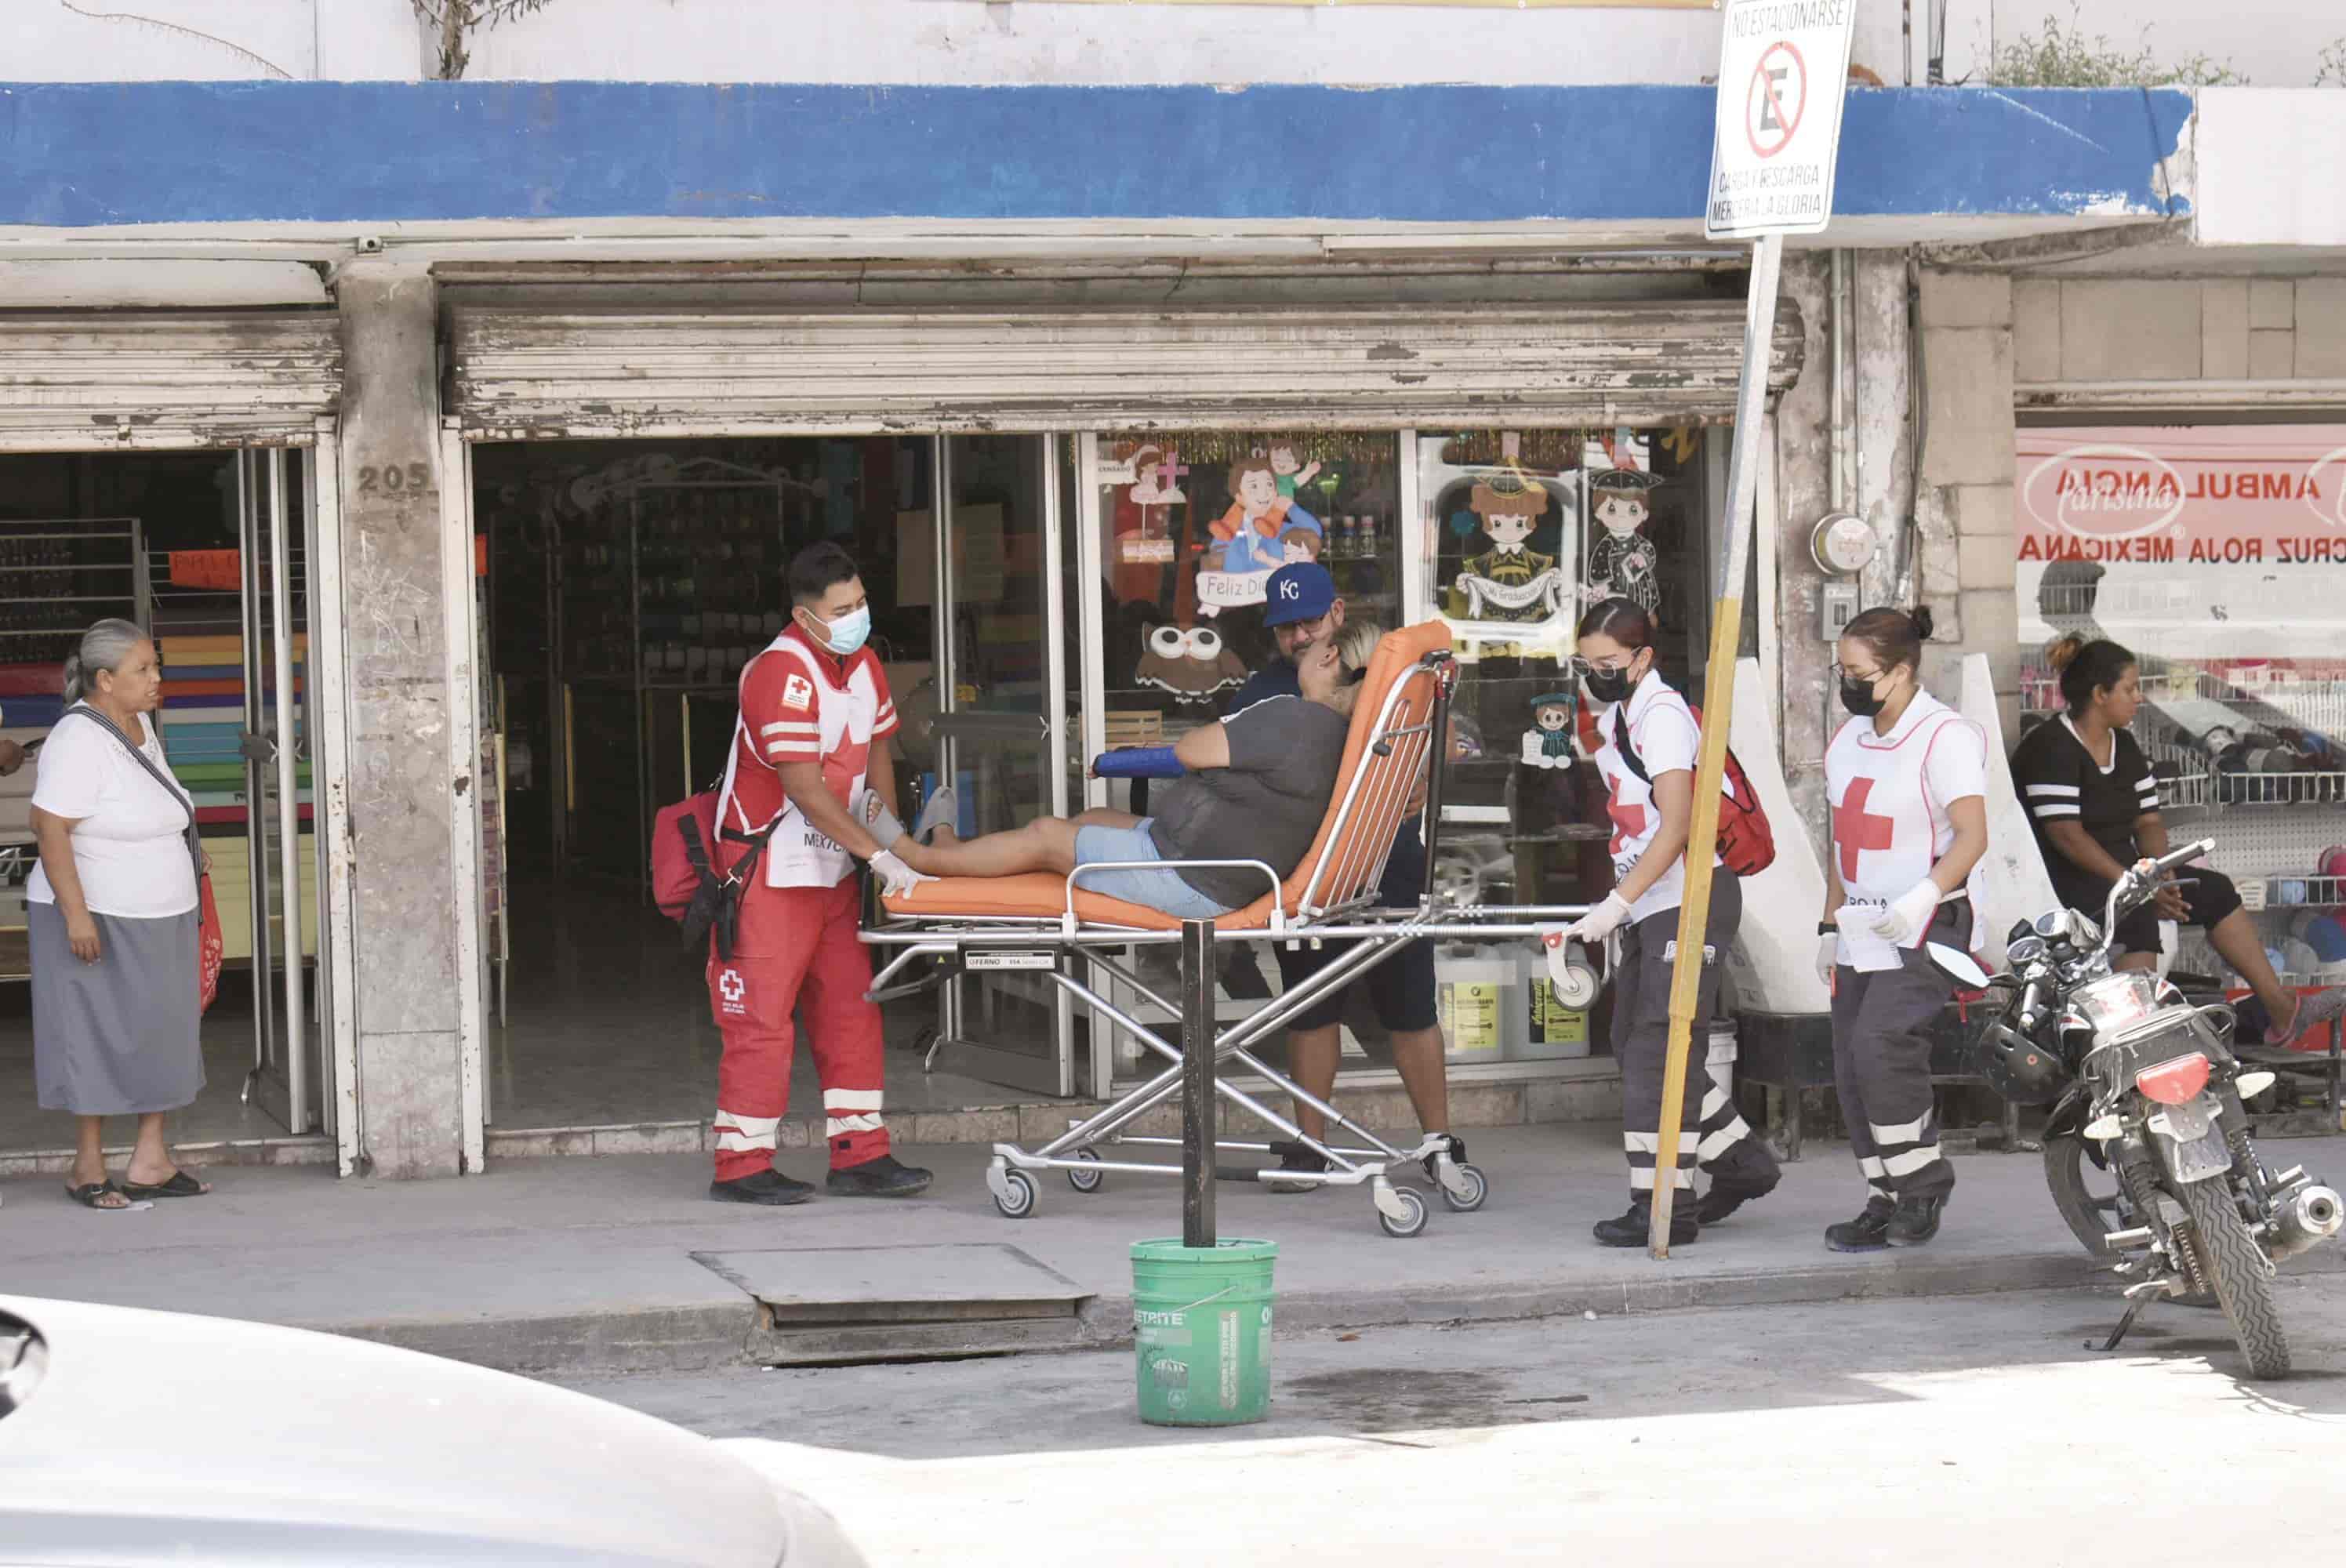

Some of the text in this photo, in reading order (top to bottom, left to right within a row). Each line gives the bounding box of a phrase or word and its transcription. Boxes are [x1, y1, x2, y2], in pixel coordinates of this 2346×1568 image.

[1733, 0, 1843, 38] NO ESTACIONARSE
[1719, 169, 1749, 194] CARGA
[1775, 194, 1821, 216] GLORIA
[358, 463, 428, 491] 205
[1206, 576, 1243, 597] Feliz
[1280, 579, 1299, 600] KC
